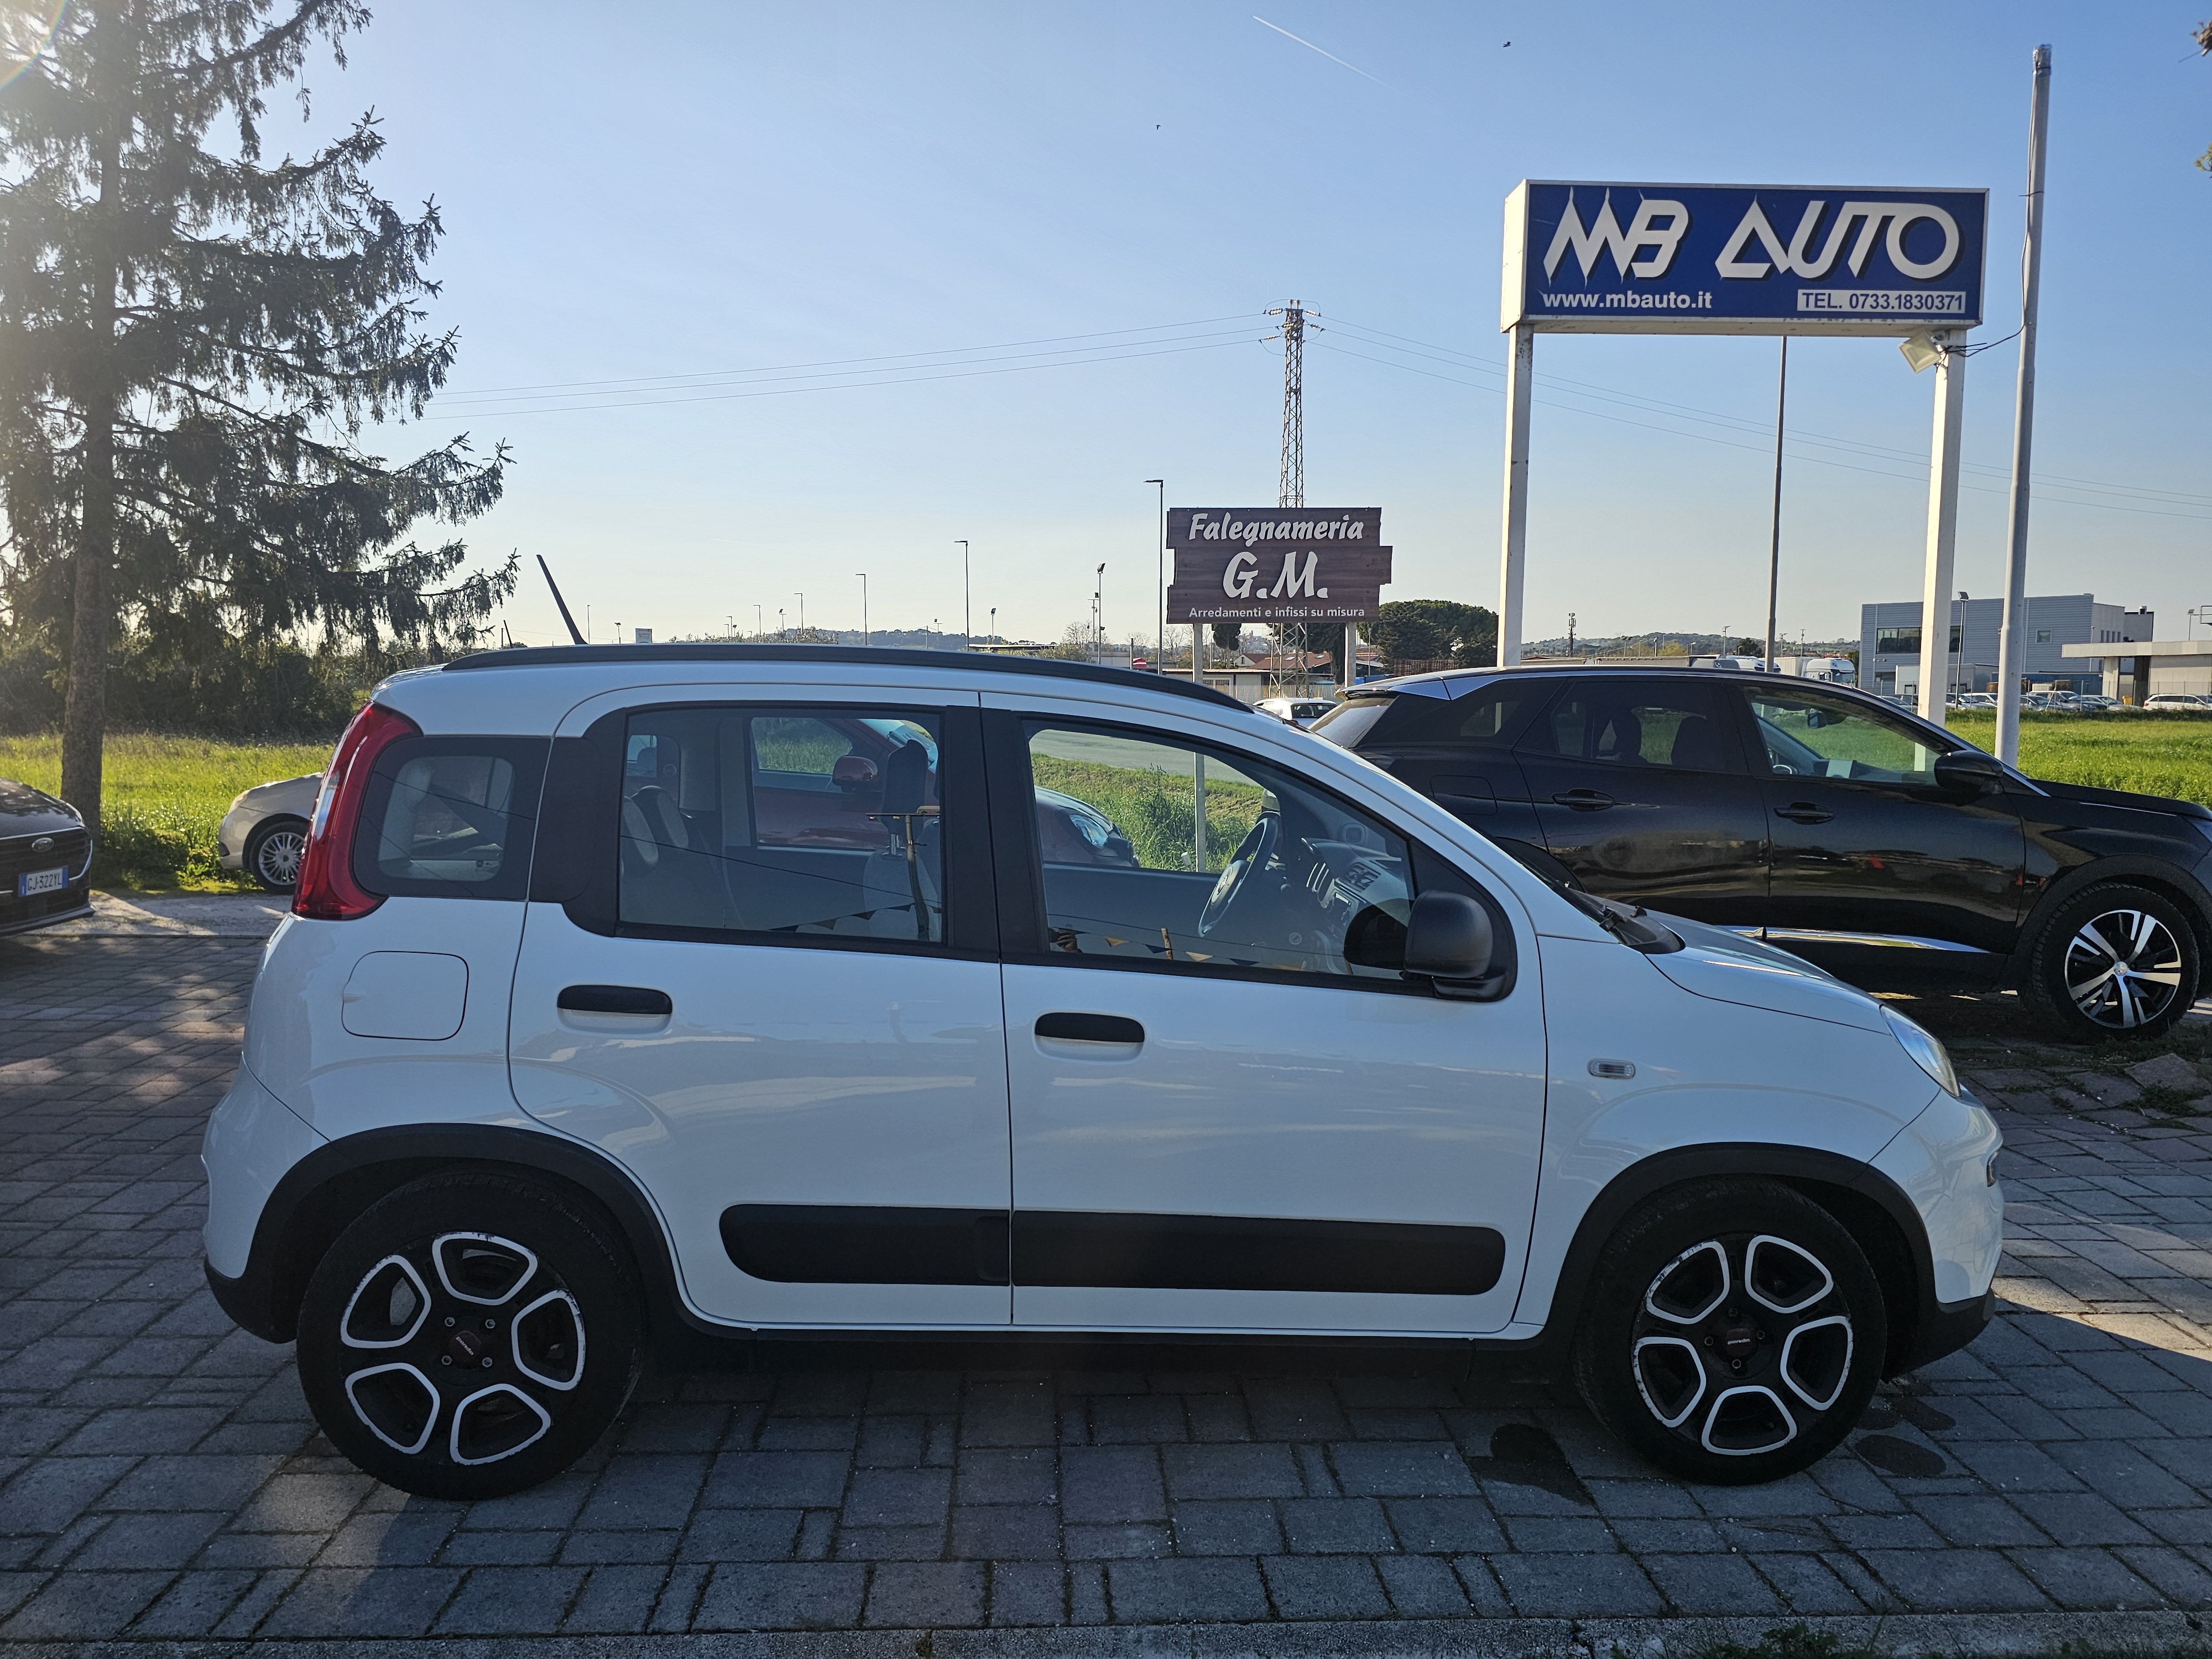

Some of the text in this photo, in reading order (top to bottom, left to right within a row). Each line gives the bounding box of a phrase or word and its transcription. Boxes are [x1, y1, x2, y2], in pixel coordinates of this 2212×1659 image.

[1543, 188, 1959, 285] MB AUTO
[1542, 291, 1713, 309] www.mbauto.it
[1802, 293, 1963, 311] TEL. 0733.1830371
[1188, 512, 1364, 547] Falegnameria
[1222, 551, 1328, 599] G.M.
[1188, 606, 1261, 618] Arredamenti
[1275, 606, 1308, 617] infissi
[1311, 609, 1323, 617] su
[1327, 606, 1365, 617] misura
